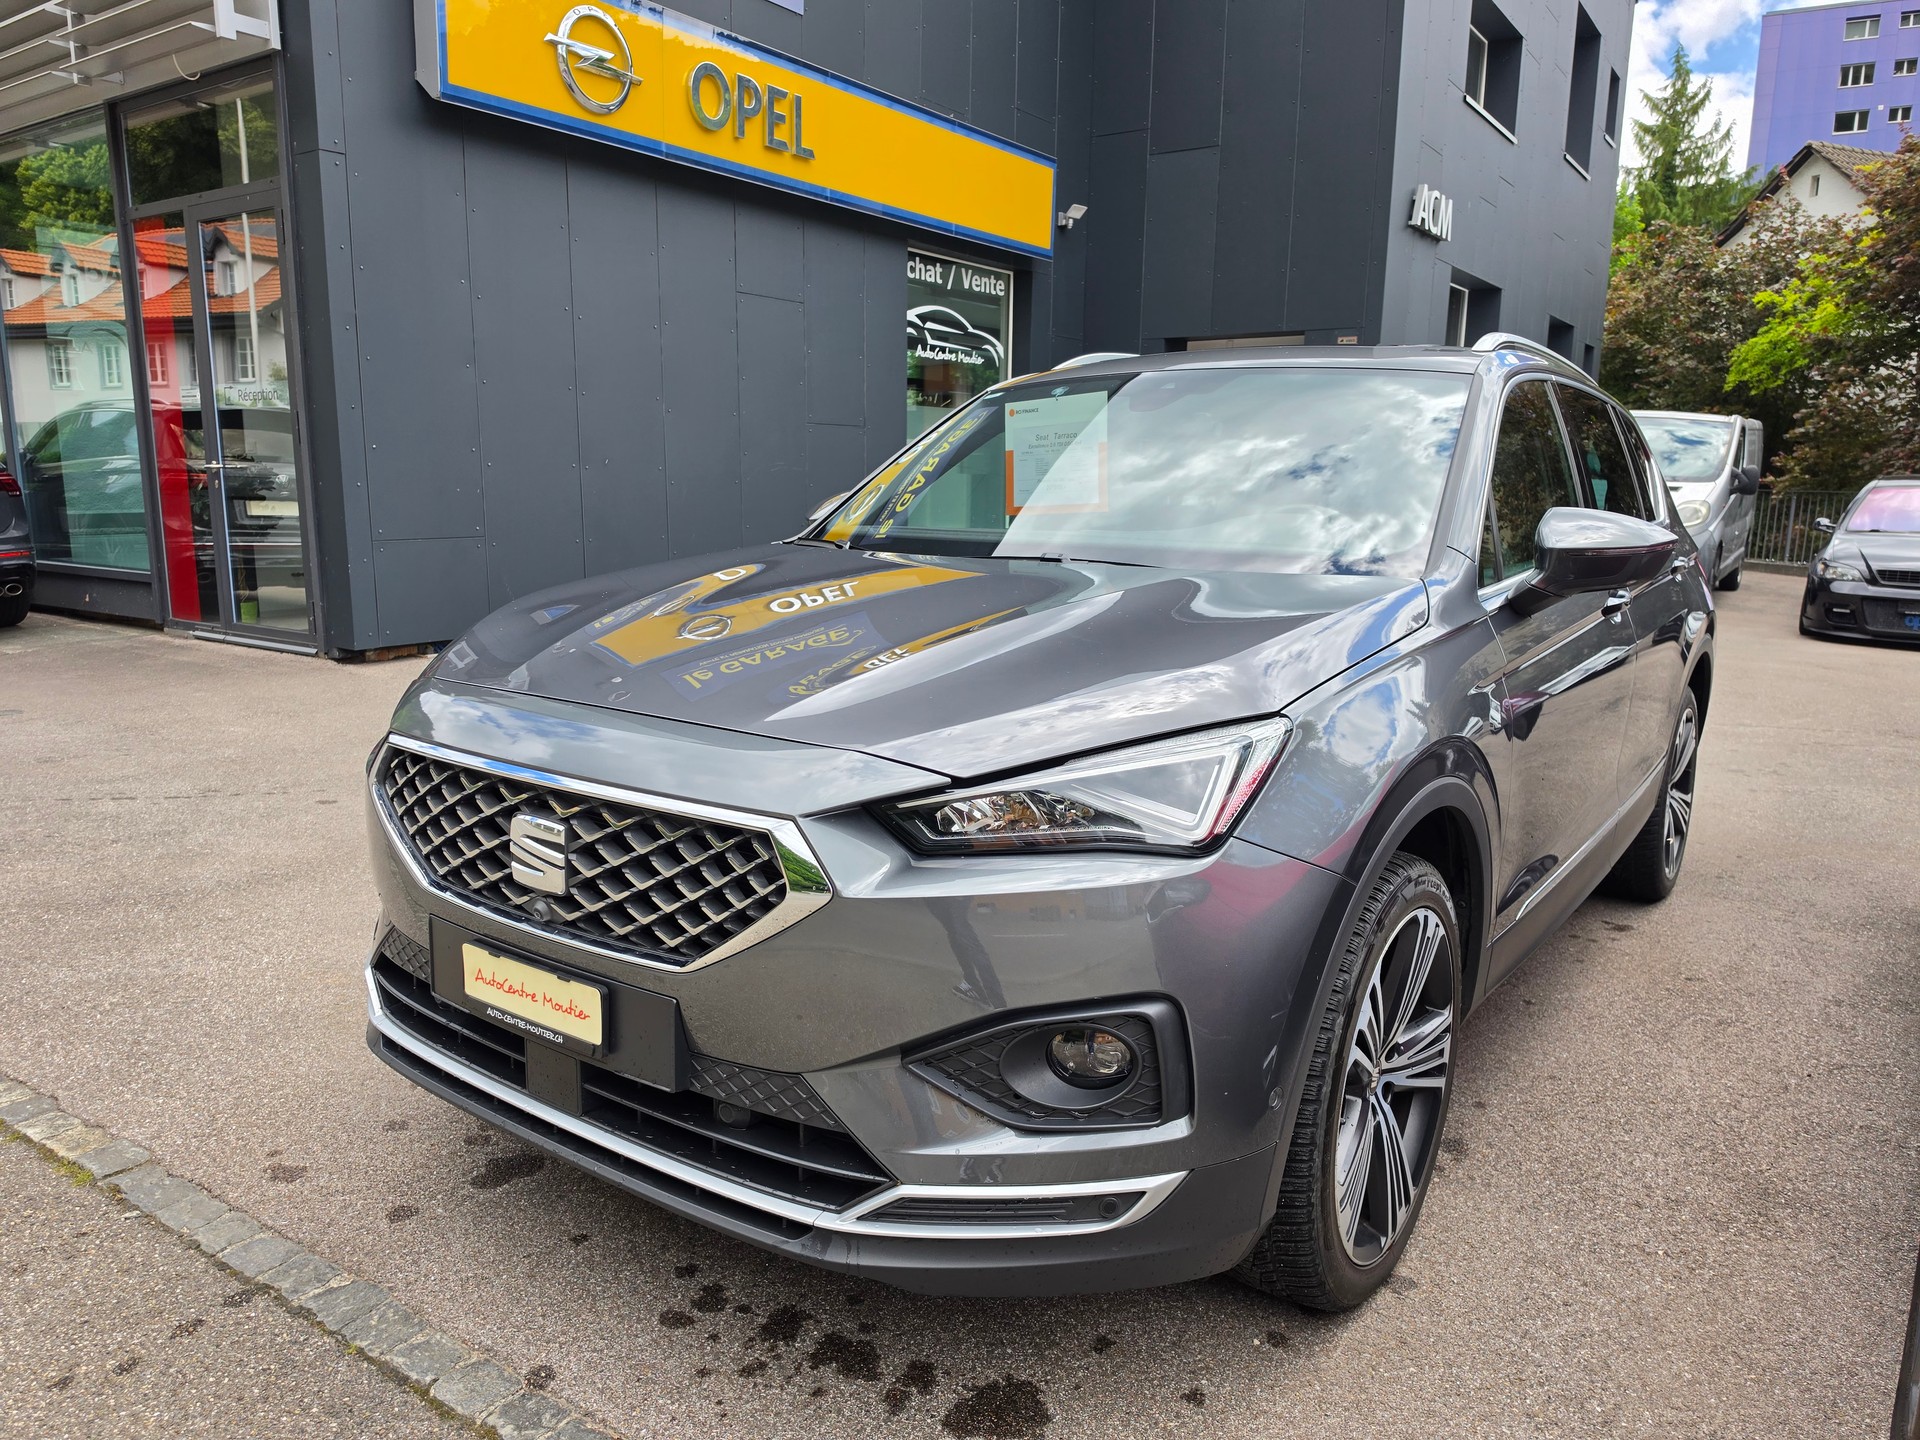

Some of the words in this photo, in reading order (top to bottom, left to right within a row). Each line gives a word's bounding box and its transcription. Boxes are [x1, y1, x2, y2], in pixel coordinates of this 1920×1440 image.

[688, 61, 815, 160] OPEL
[1415, 185, 1453, 241] ACM
[947, 265, 956, 289] /
[961, 268, 1005, 296] Vente
[915, 344, 957, 362] AutoCentre
[957, 350, 985, 365] Moutier
[237, 388, 279, 405] Réception
[1035, 434, 1049, 442] Seat
[1054, 432, 1077, 440] Tarraco
[475, 968, 538, 1003] AutoCentre
[543, 992, 591, 1021] Moutier
[487, 1007, 564, 1044] AUTO-CENTRE-MOUTIER.CH
